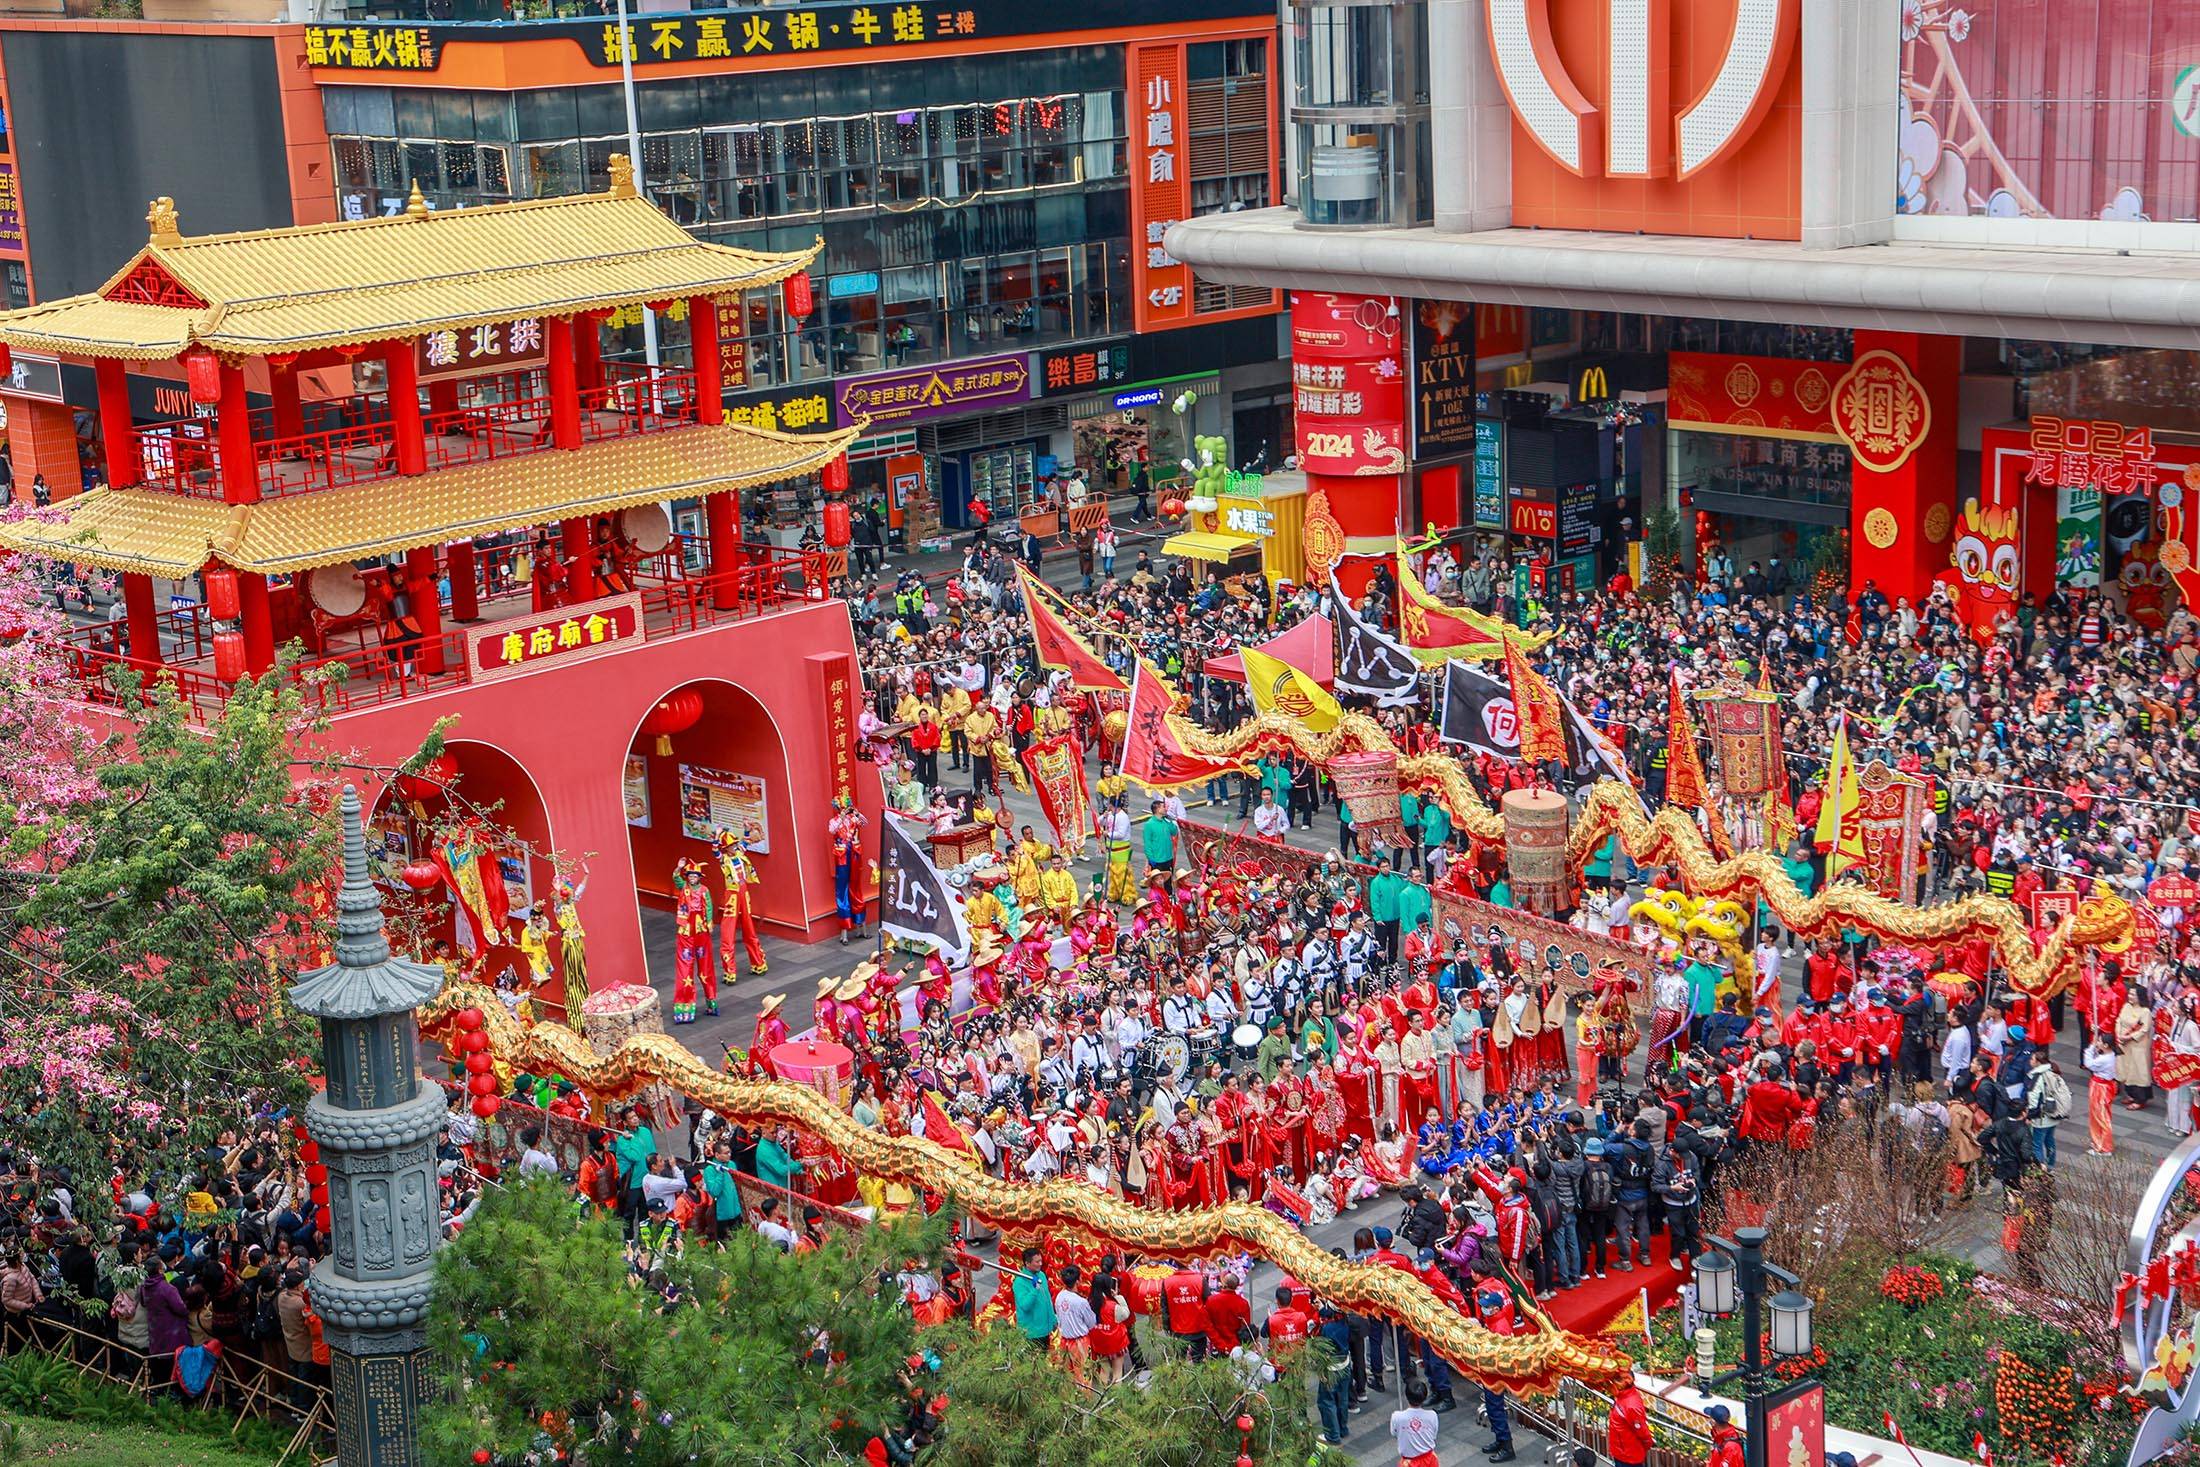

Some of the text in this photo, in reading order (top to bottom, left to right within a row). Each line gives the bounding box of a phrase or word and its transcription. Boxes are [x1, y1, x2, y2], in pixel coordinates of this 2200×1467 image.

[305, 27, 421, 67] 搞不赢火锅
[603, 5, 976, 63] 搞不赢火锅·牛蛙 三楼
[1163, 286, 1182, 304] 2F
[721, 344, 743, 358] 左边
[721, 360, 743, 372] 入口
[1003, 370, 1021, 383] SPA
[1048, 352, 1097, 389] 樂富
[1420, 354, 1470, 385] KTV
[1874, 390, 1888, 428] 大吉
[1306, 432, 1354, 459] 2024
[2030, 415, 2156, 461] 2024
[2025, 449, 2158, 496] 龙腾花开
[1226, 507, 1258, 533] 水果
[500, 612, 610, 665] 廣府廟會
